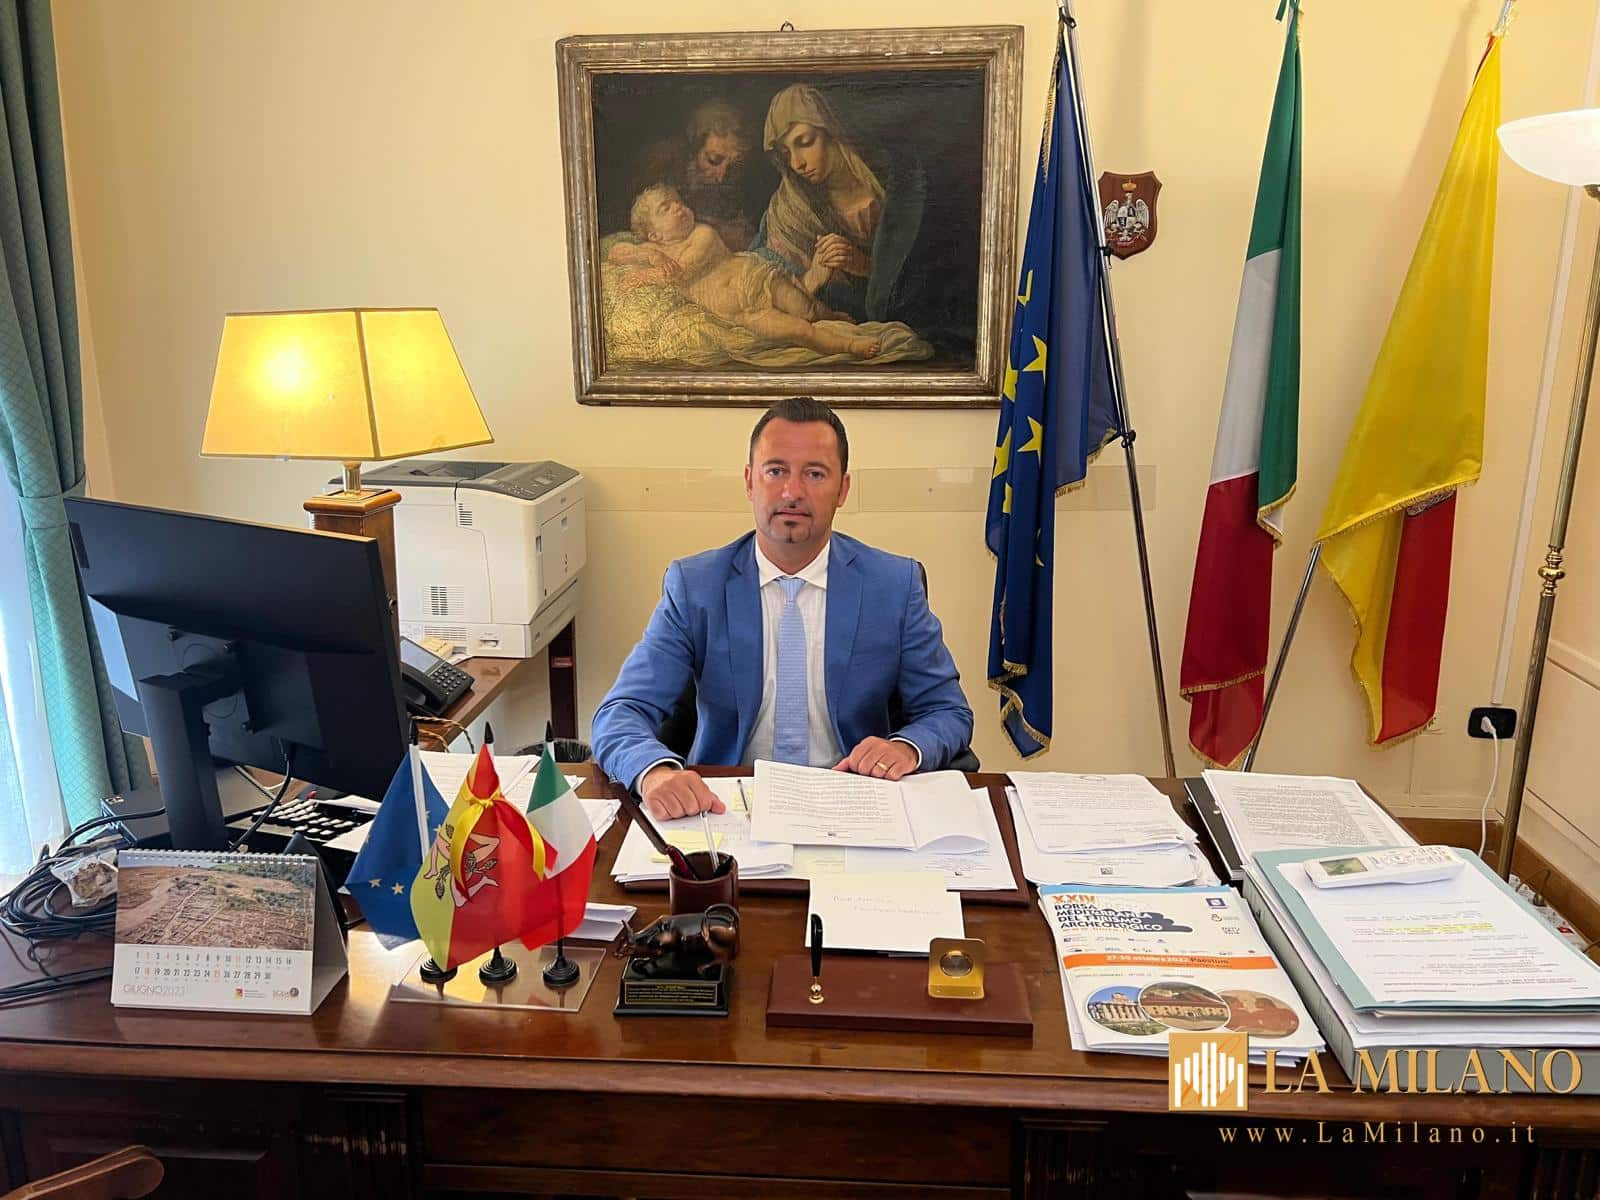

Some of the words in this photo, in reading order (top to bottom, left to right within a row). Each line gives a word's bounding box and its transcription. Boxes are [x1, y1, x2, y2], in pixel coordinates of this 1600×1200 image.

[1054, 903, 1098, 911] BORSA
[1085, 916, 1142, 924] TURISMO
[1060, 922, 1163, 931] ARCHEOLOGICO
